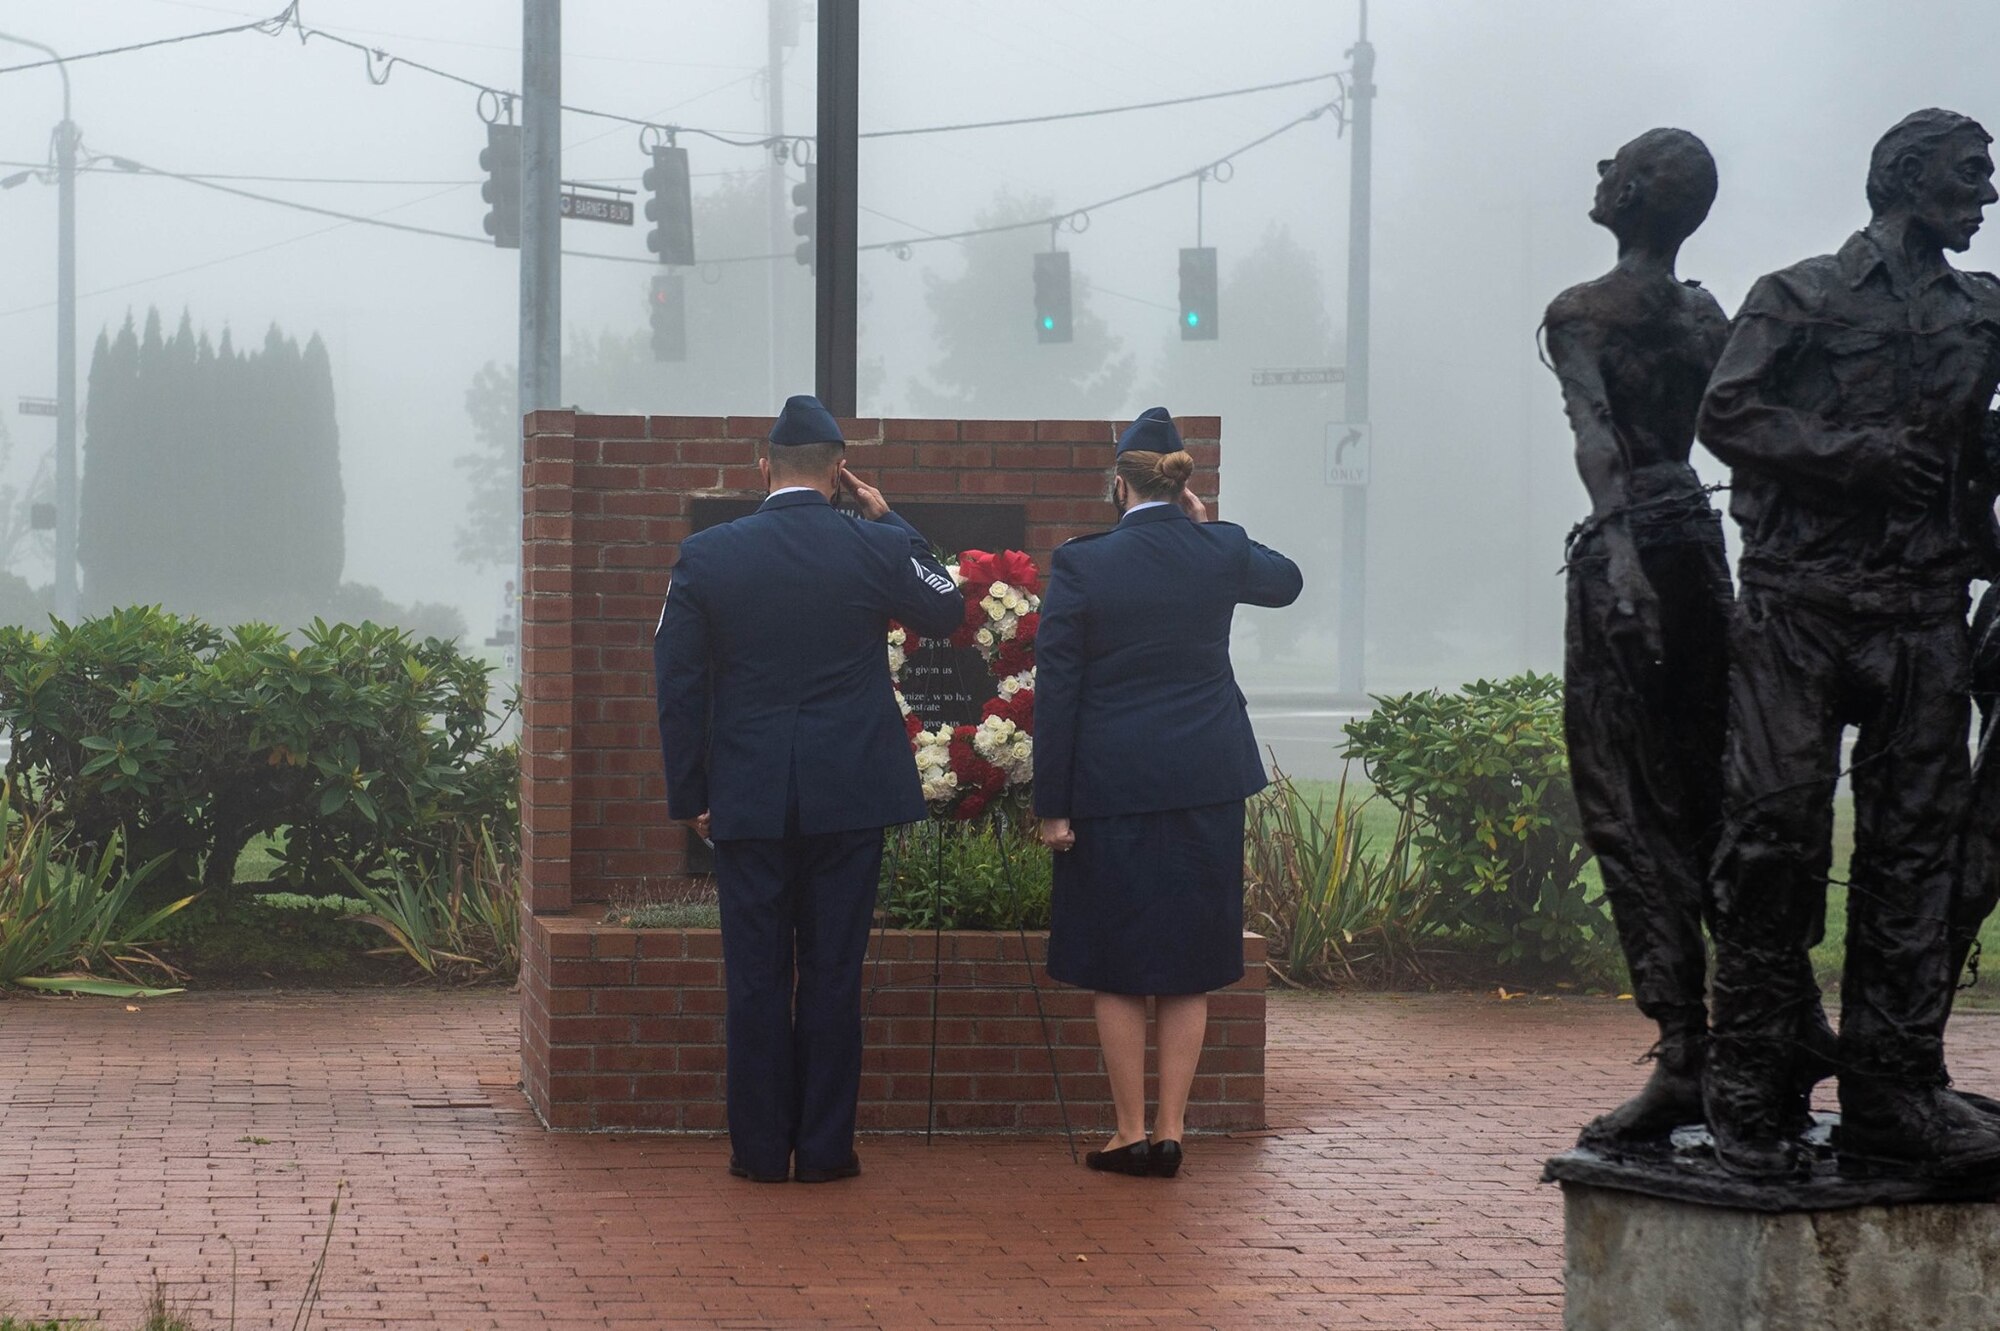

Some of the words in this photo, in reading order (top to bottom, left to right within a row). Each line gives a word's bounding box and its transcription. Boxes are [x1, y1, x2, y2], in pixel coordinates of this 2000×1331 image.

[575, 199, 608, 218] BARNES
[610, 204, 630, 221] BLVD
[1330, 468, 1364, 481] ONLY
[942, 667, 953, 675] us
